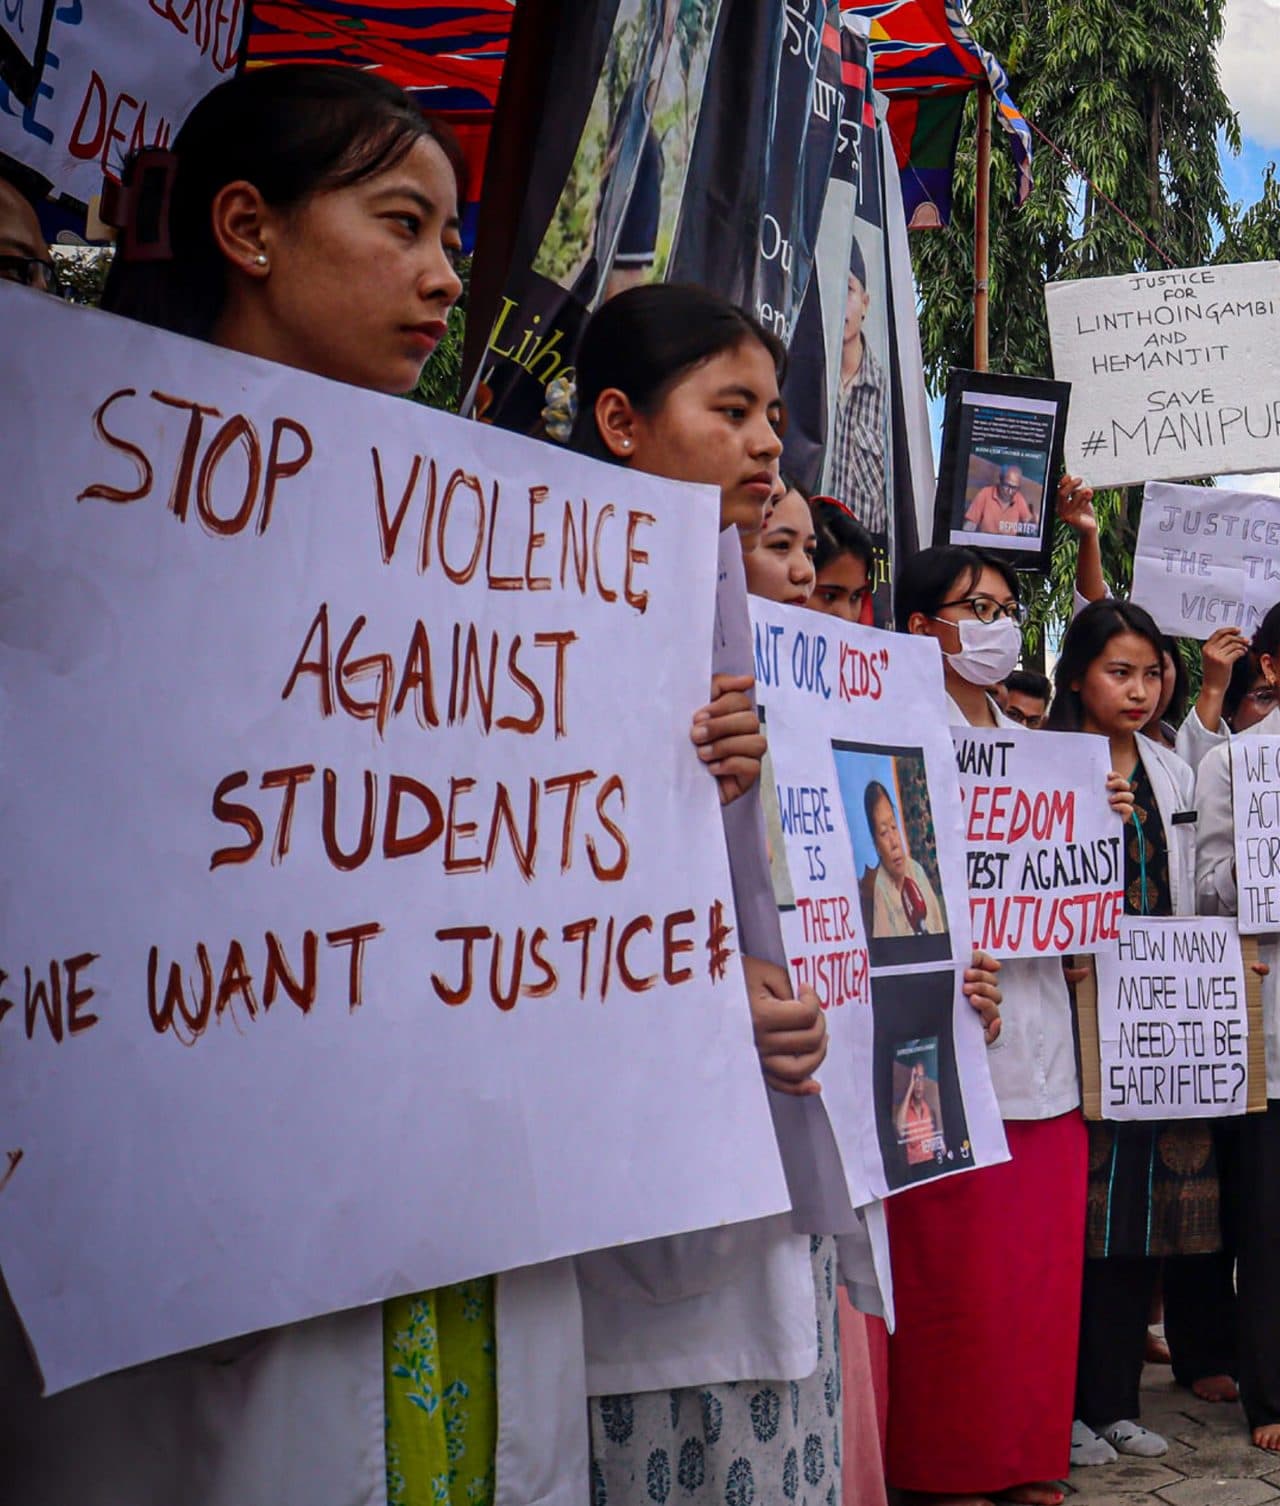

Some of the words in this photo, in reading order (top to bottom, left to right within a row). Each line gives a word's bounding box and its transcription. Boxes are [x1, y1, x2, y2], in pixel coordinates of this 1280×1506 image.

[1129, 271, 1216, 290] JUSTICE
[1163, 289, 1197, 301] FOR
[1077, 301, 1274, 335] LINTHOINGAMBI
[1144, 331, 1187, 347] AND
[1092, 345, 1229, 374] HEMANJIT
[1147, 388, 1214, 412] SAVE
[77, 388, 313, 537] STOP
[371, 446, 657, 614] VIOLENCE
[1159, 505, 1280, 545] JUSTICE
[1162, 548, 1213, 576] THE
[283, 602, 578, 740] AGAINST
[793, 630, 831, 700] OUR
[1244, 746, 1272, 783] WE
[210, 764, 628, 884] STUDENTS
[777, 783, 834, 835] WHERE
[960, 786, 1075, 844] EEDOM
[804, 846, 826, 881] IS
[1021, 837, 1120, 891] AGAINST
[796, 896, 855, 944] THEIR
[970, 890, 1125, 952] INJUSTICE
[1244, 886, 1280, 924] THE
[1117, 928, 1166, 962] HOW
[1173, 930, 1228, 963] MANY
[148, 922, 387, 1047] WANT
[1117, 975, 1177, 1011] MORE
[1185, 976, 1238, 1010] LIVES
[1119, 1021, 1175, 1059] NEED
[1179, 1021, 1205, 1057] TO
[1214, 1019, 1242, 1056] BE
[1109, 1063, 1246, 1105] SACRIFICE?
